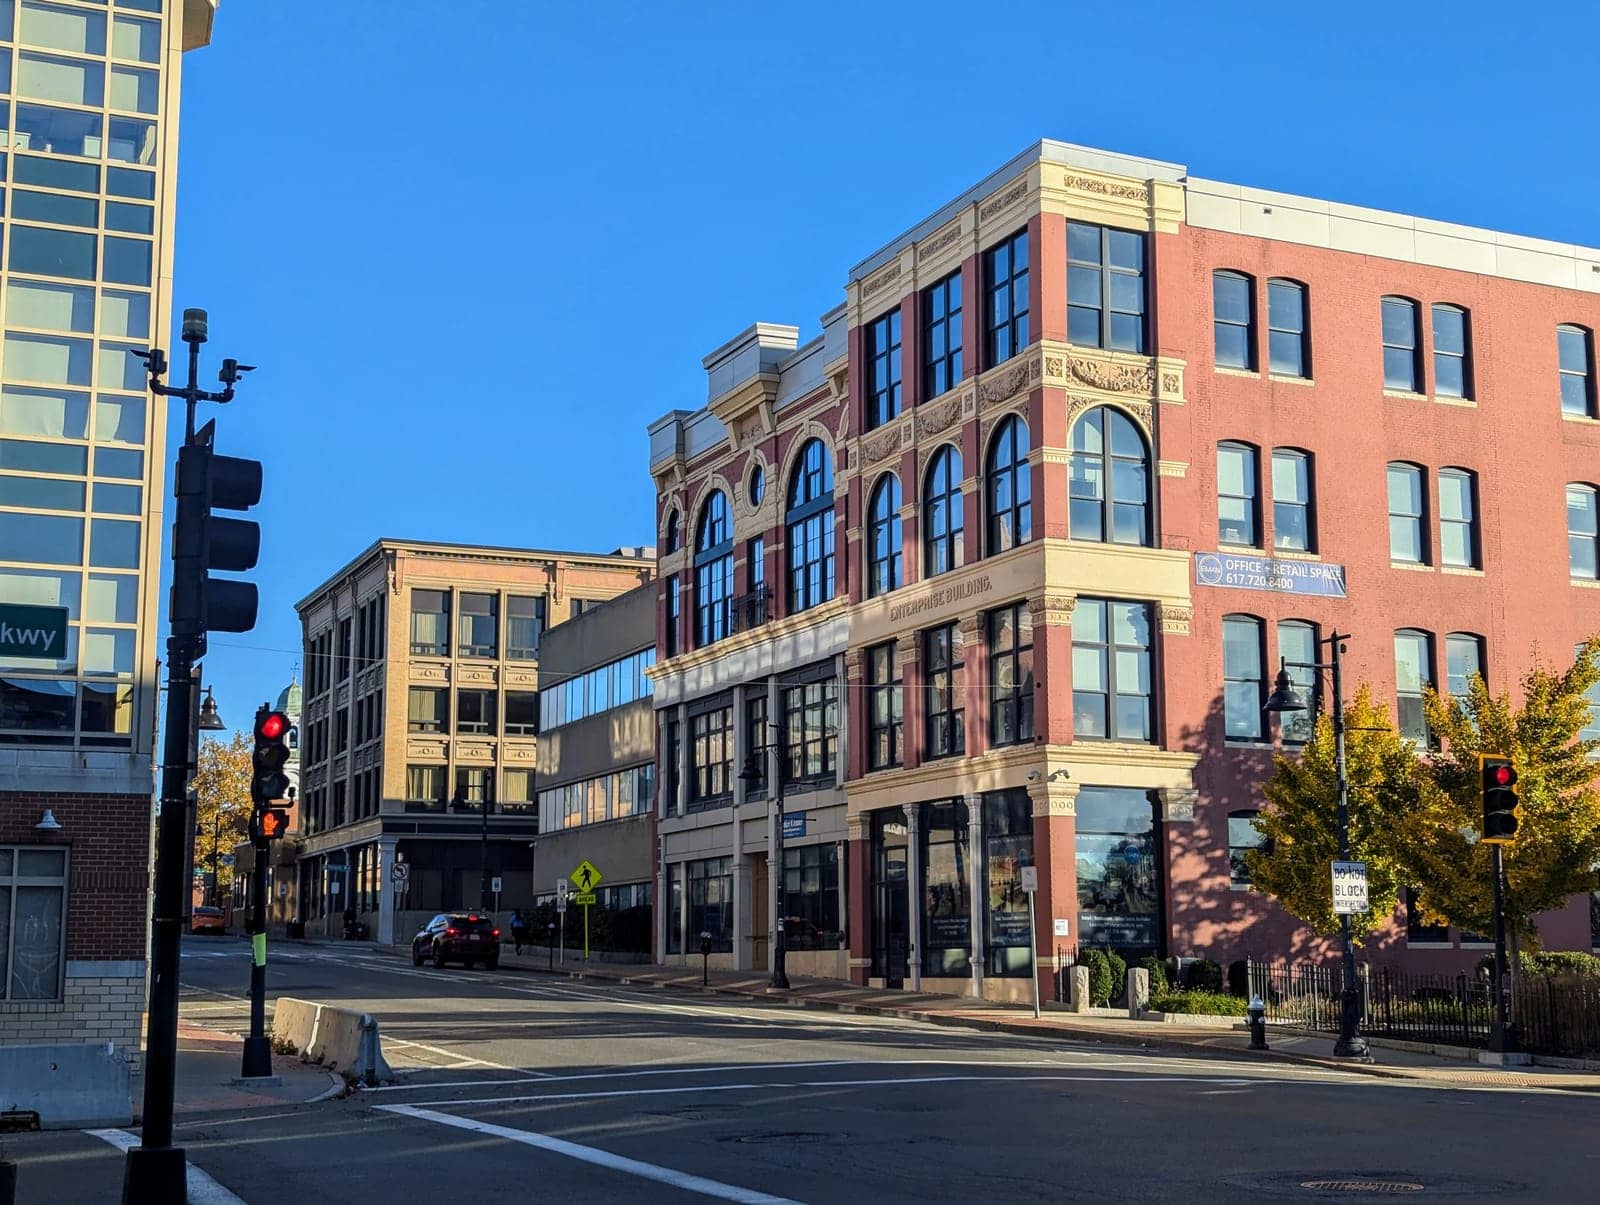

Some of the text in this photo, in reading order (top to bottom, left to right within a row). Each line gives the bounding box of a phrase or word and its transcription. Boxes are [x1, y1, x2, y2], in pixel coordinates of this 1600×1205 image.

[1225, 559, 1262, 573] OFFICE
[1273, 563, 1307, 577] RETAIL
[1226, 573, 1293, 589] 617.720.8400
[890, 590, 945, 622] ENTERPRISE
[1334, 868, 1365, 881] DO NOT
[1335, 884, 1366, 897] BLOCK
